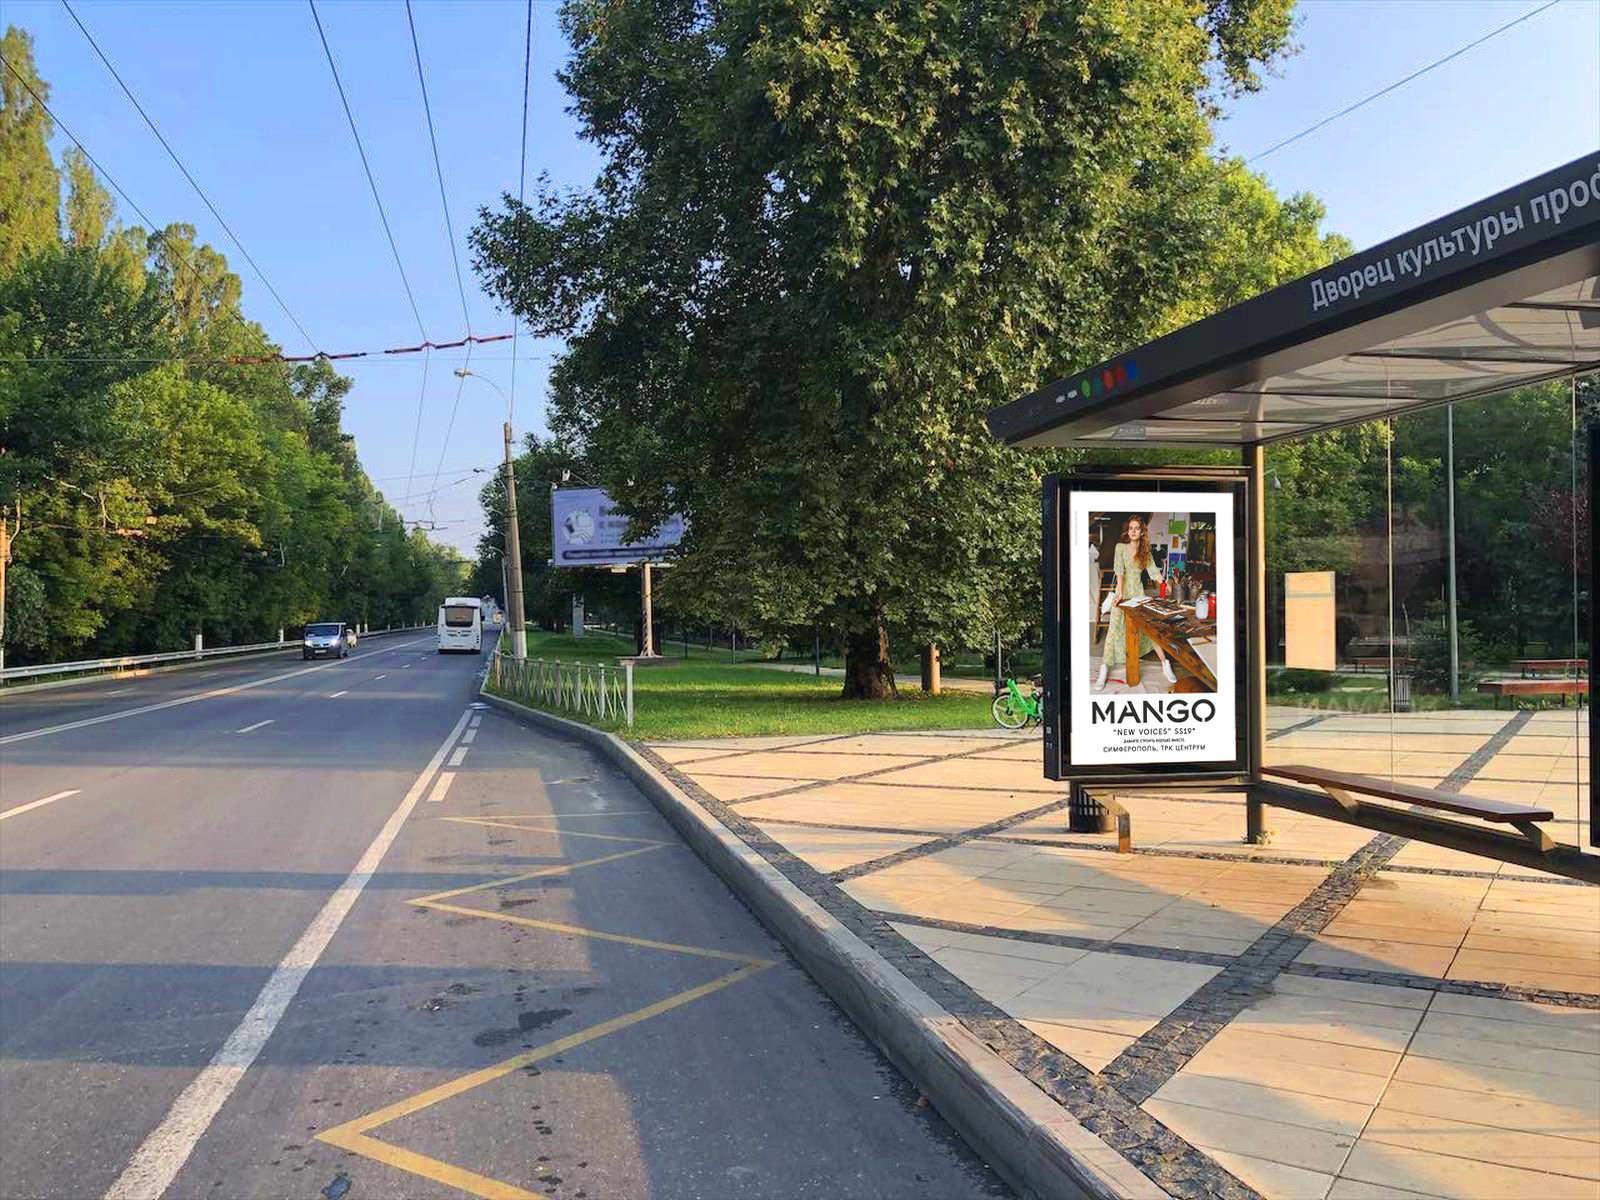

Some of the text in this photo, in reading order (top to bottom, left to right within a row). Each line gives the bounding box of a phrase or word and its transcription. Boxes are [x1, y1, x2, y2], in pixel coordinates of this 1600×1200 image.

[1310, 257, 1395, 310] Дворец
[1399, 205, 1524, 277] культуры
[1092, 699, 1216, 724] MANGO
